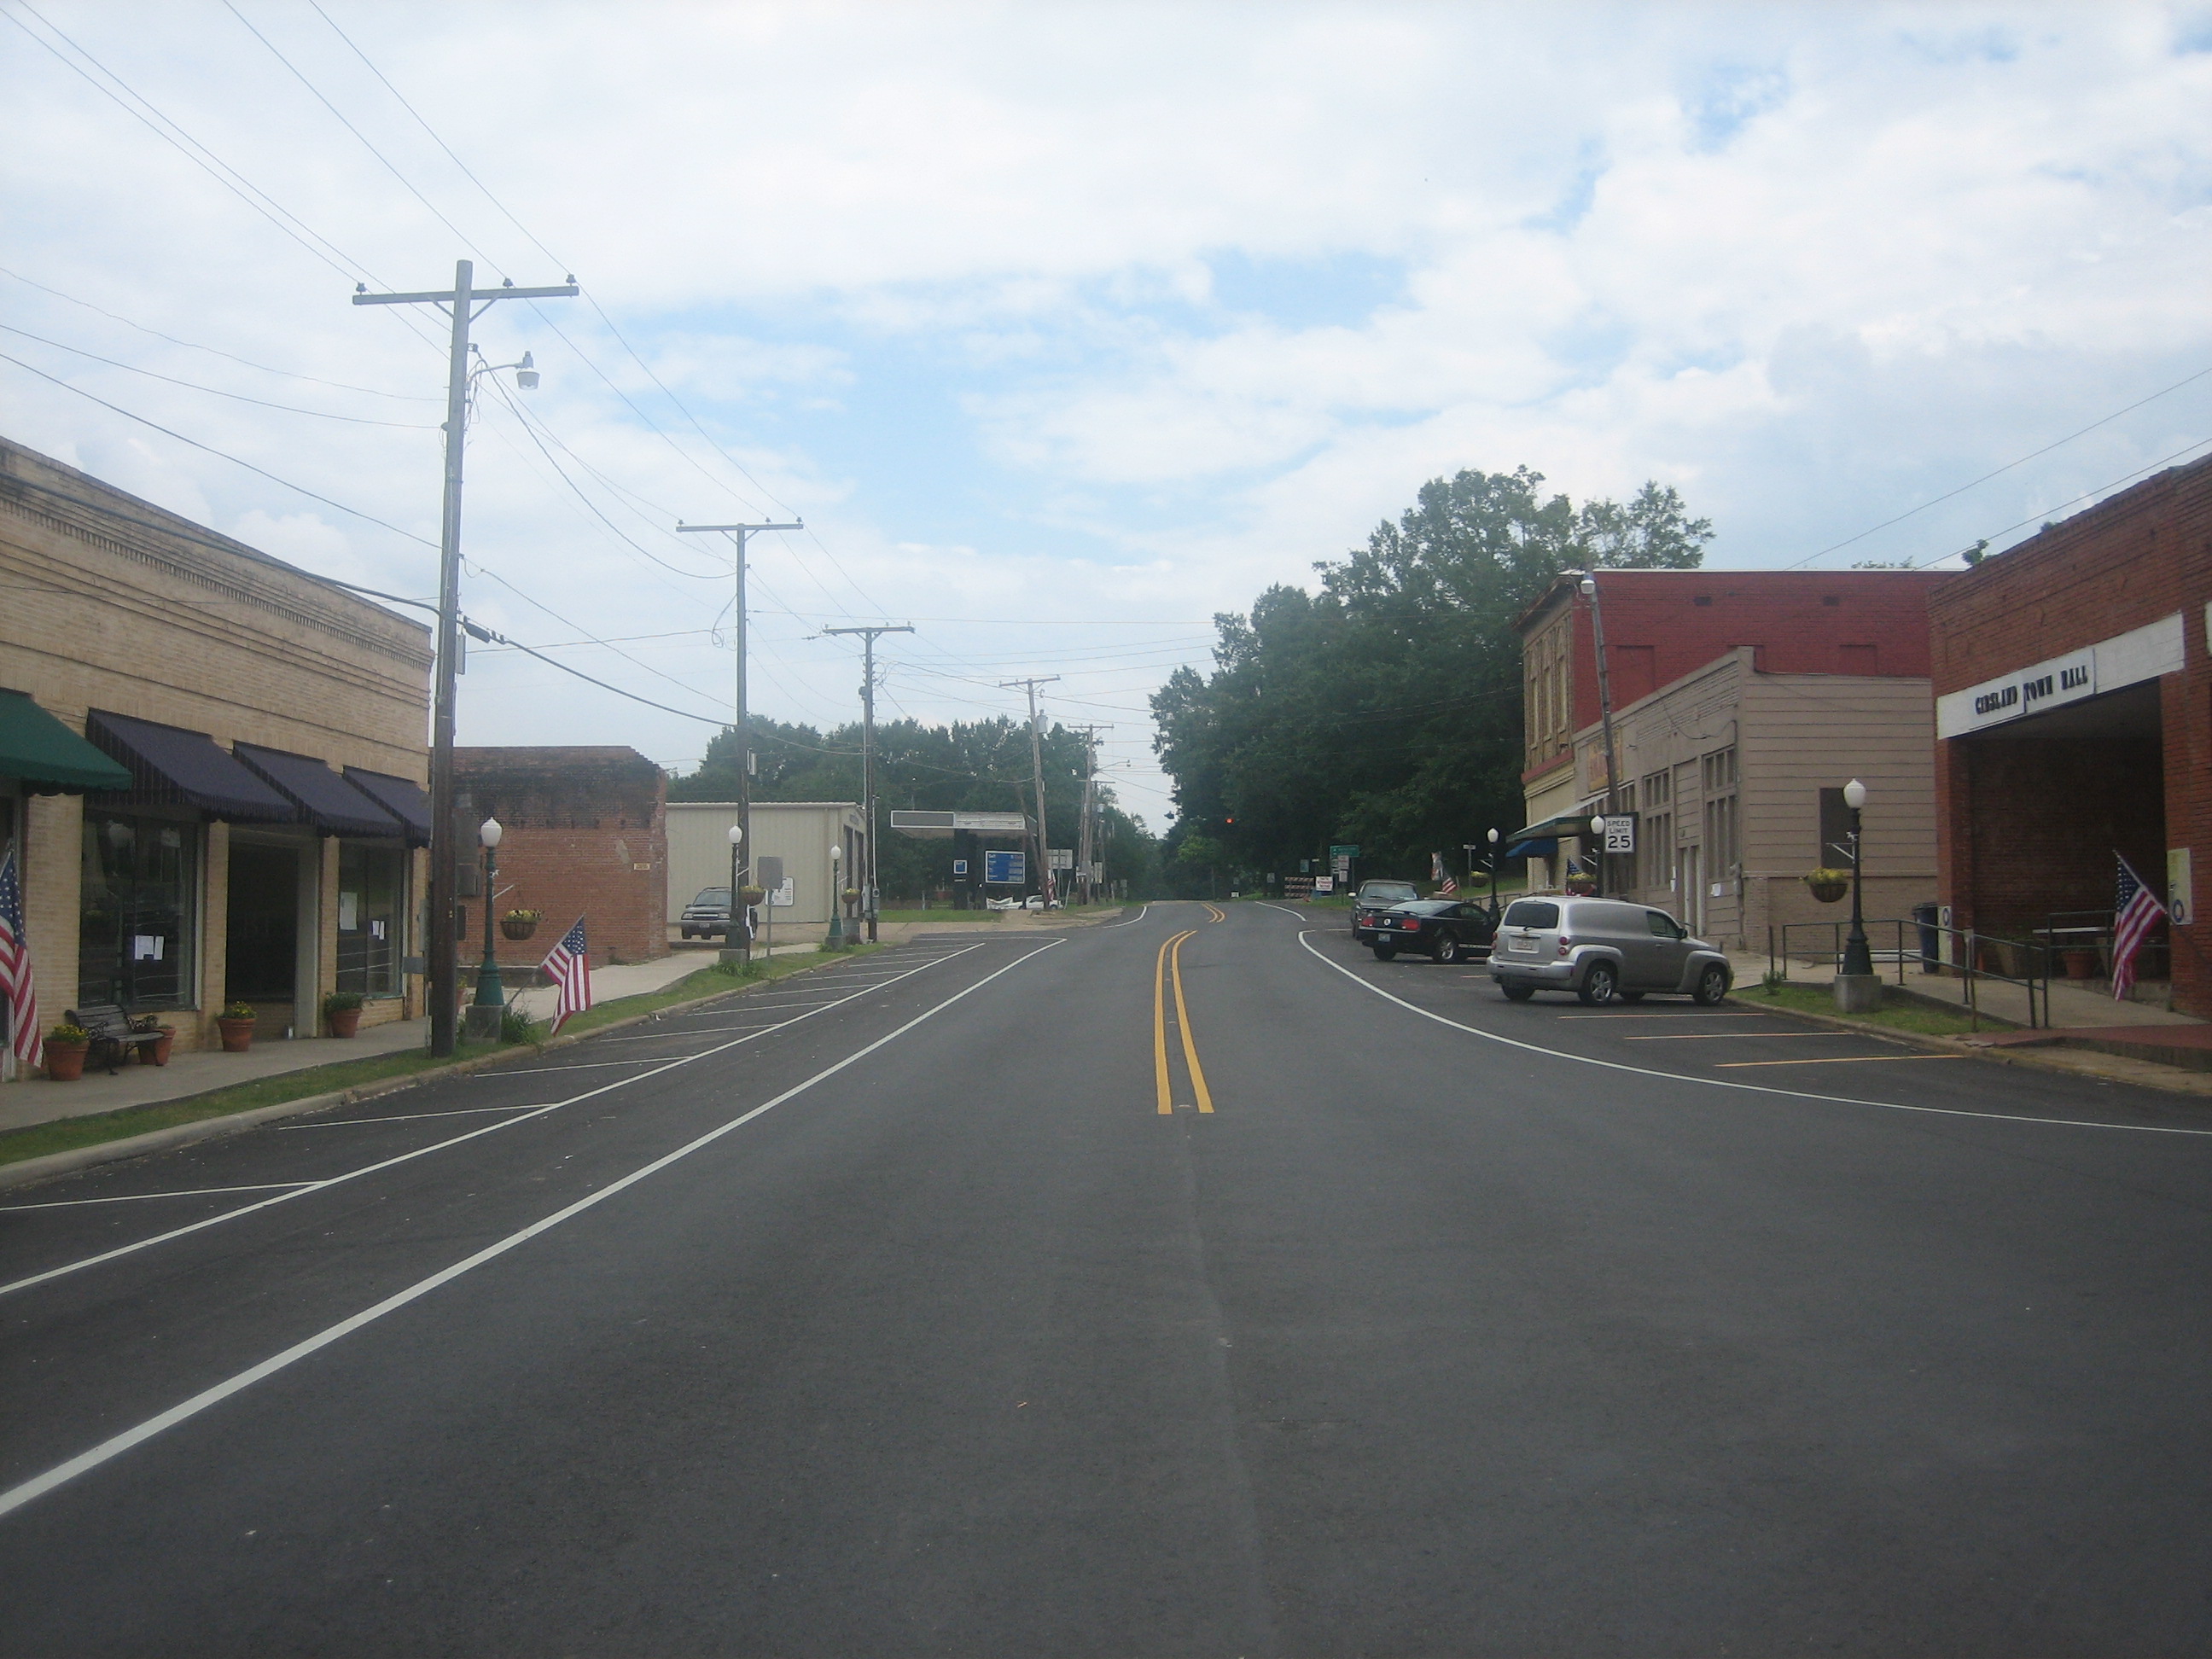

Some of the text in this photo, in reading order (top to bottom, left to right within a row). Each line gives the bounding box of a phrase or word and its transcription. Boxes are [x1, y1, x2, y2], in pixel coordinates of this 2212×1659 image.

[2023, 675, 2053, 701] TOWN
[2061, 665, 2088, 690] HALL
[1608, 835, 1631, 848] 25
